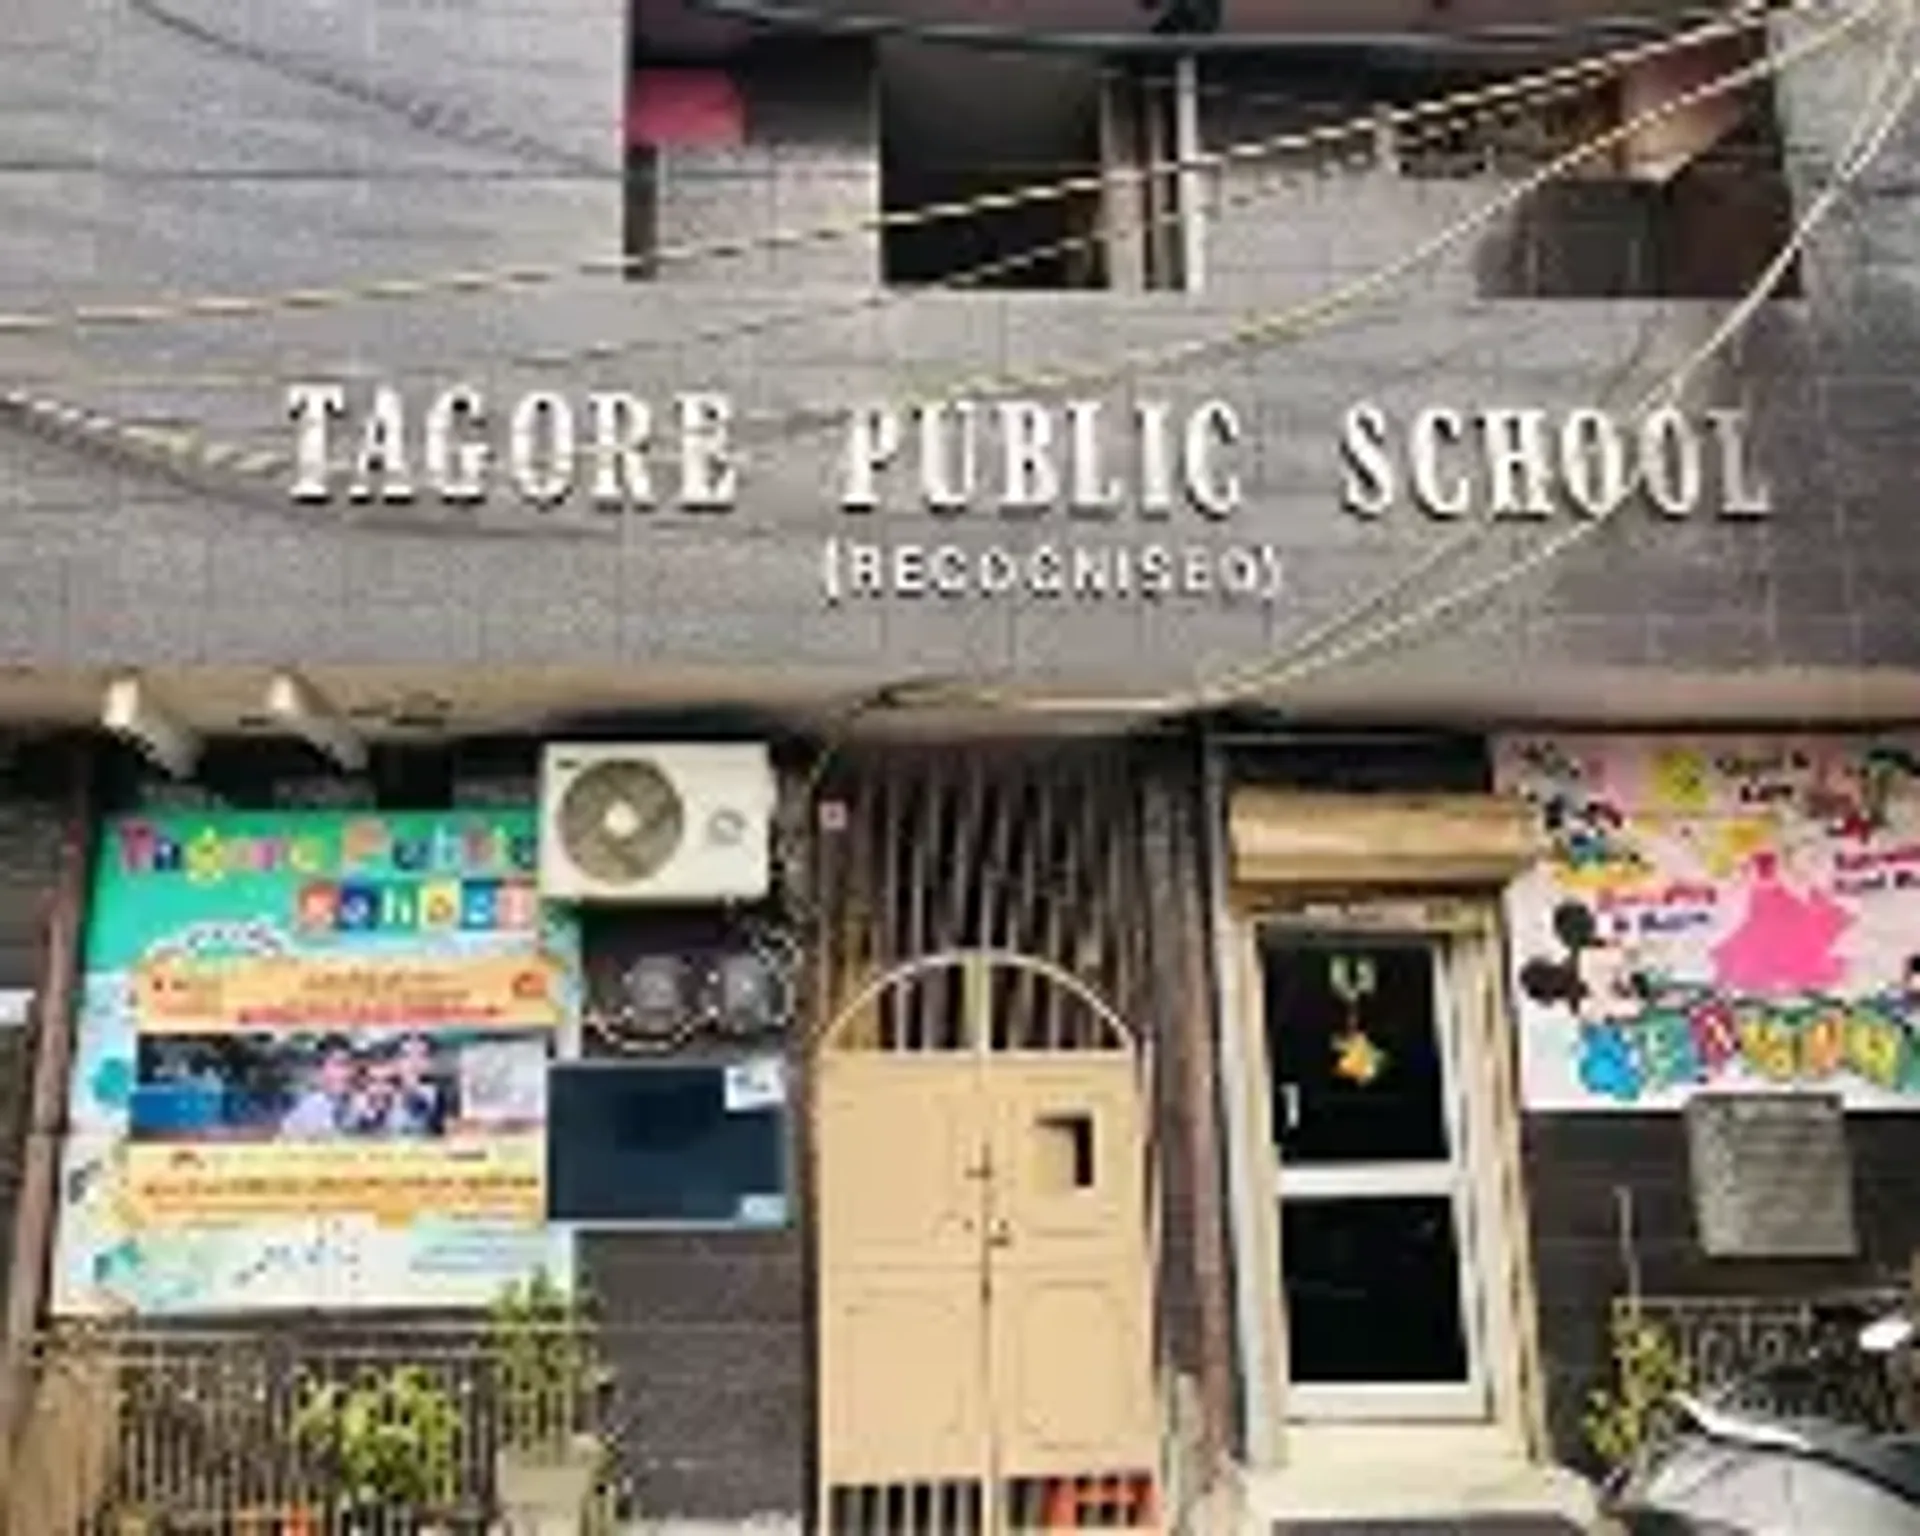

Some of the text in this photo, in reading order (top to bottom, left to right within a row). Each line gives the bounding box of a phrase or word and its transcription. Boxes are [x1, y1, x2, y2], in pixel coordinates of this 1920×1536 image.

[286, 383, 1772, 520] TAGORE PUBLIC SCHOOL
